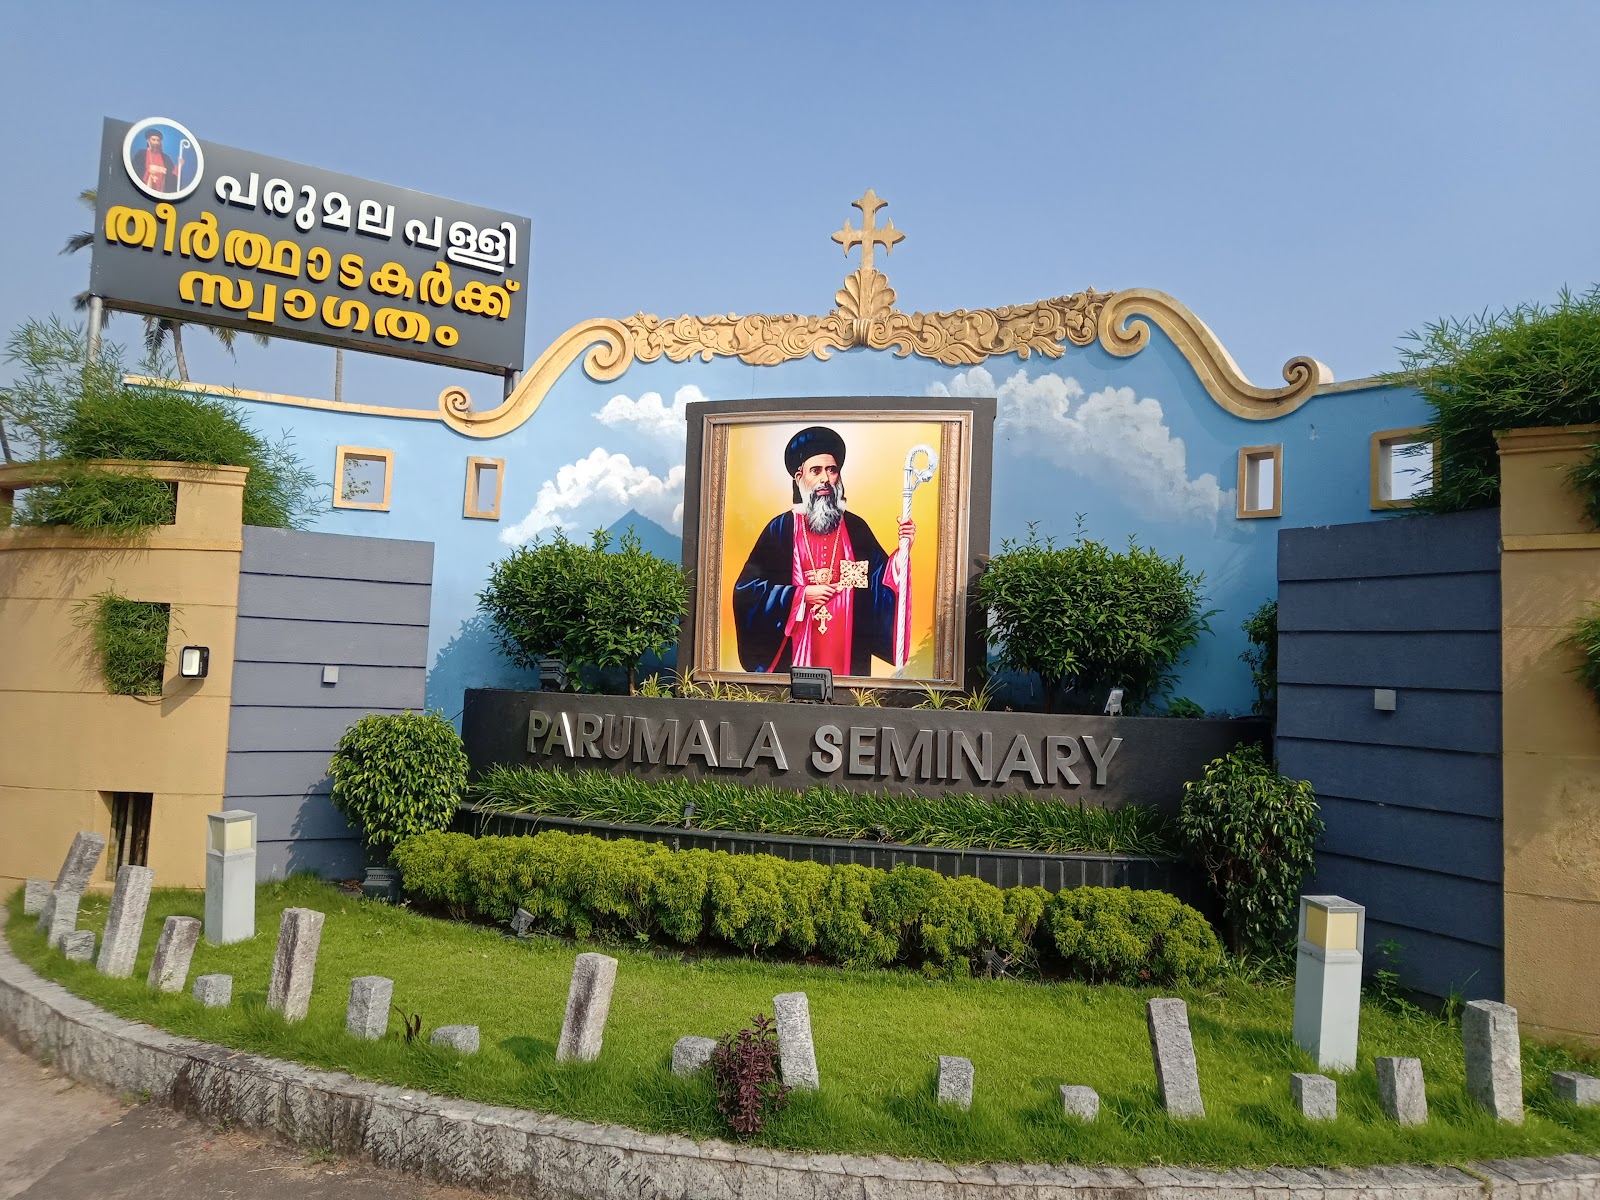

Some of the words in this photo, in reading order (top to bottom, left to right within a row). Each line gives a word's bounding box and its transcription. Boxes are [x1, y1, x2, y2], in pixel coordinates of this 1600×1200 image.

[104, 202, 520, 320] തീർത്ഥാടകർക്ക്
[214, 172, 395, 238] പരുമല
[404, 215, 518, 273] പള്ളി
[178, 270, 460, 348] സ്വാഗതം
[526, 710, 789, 771] PARUMALA
[811, 724, 1124, 787] SEMINARY
